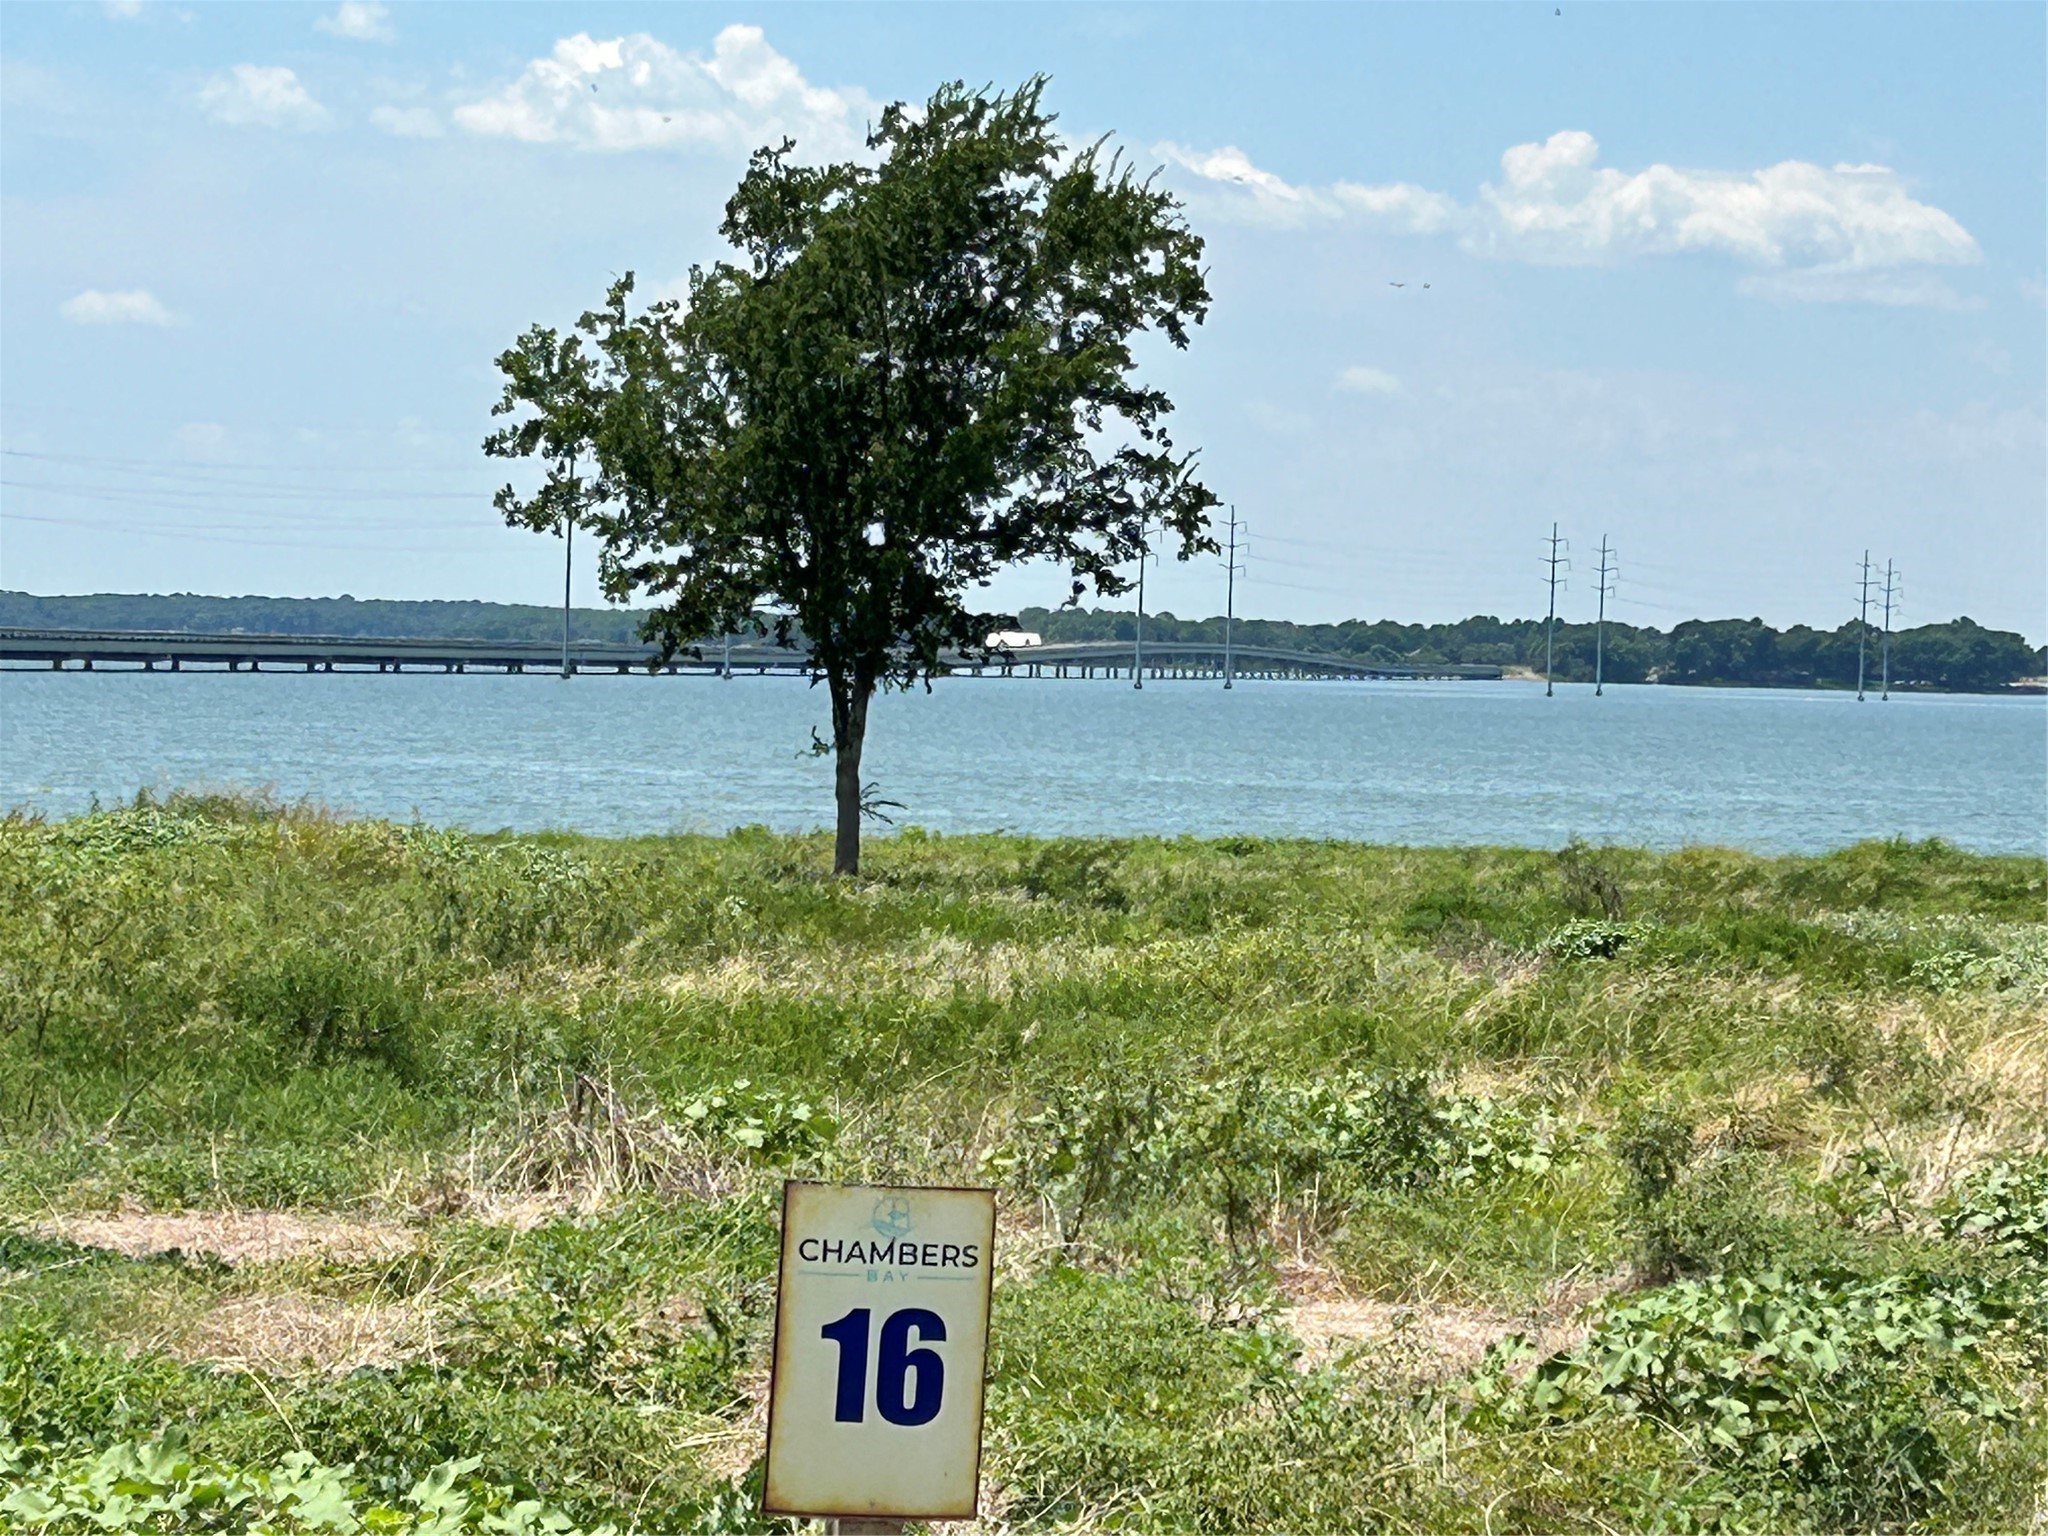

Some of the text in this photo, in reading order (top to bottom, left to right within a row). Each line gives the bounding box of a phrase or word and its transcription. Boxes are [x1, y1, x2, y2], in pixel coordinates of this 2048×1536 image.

[799, 1238, 979, 1268] CHAMBERS
[867, 1269, 909, 1283] BAY
[821, 1307, 947, 1427] 16
